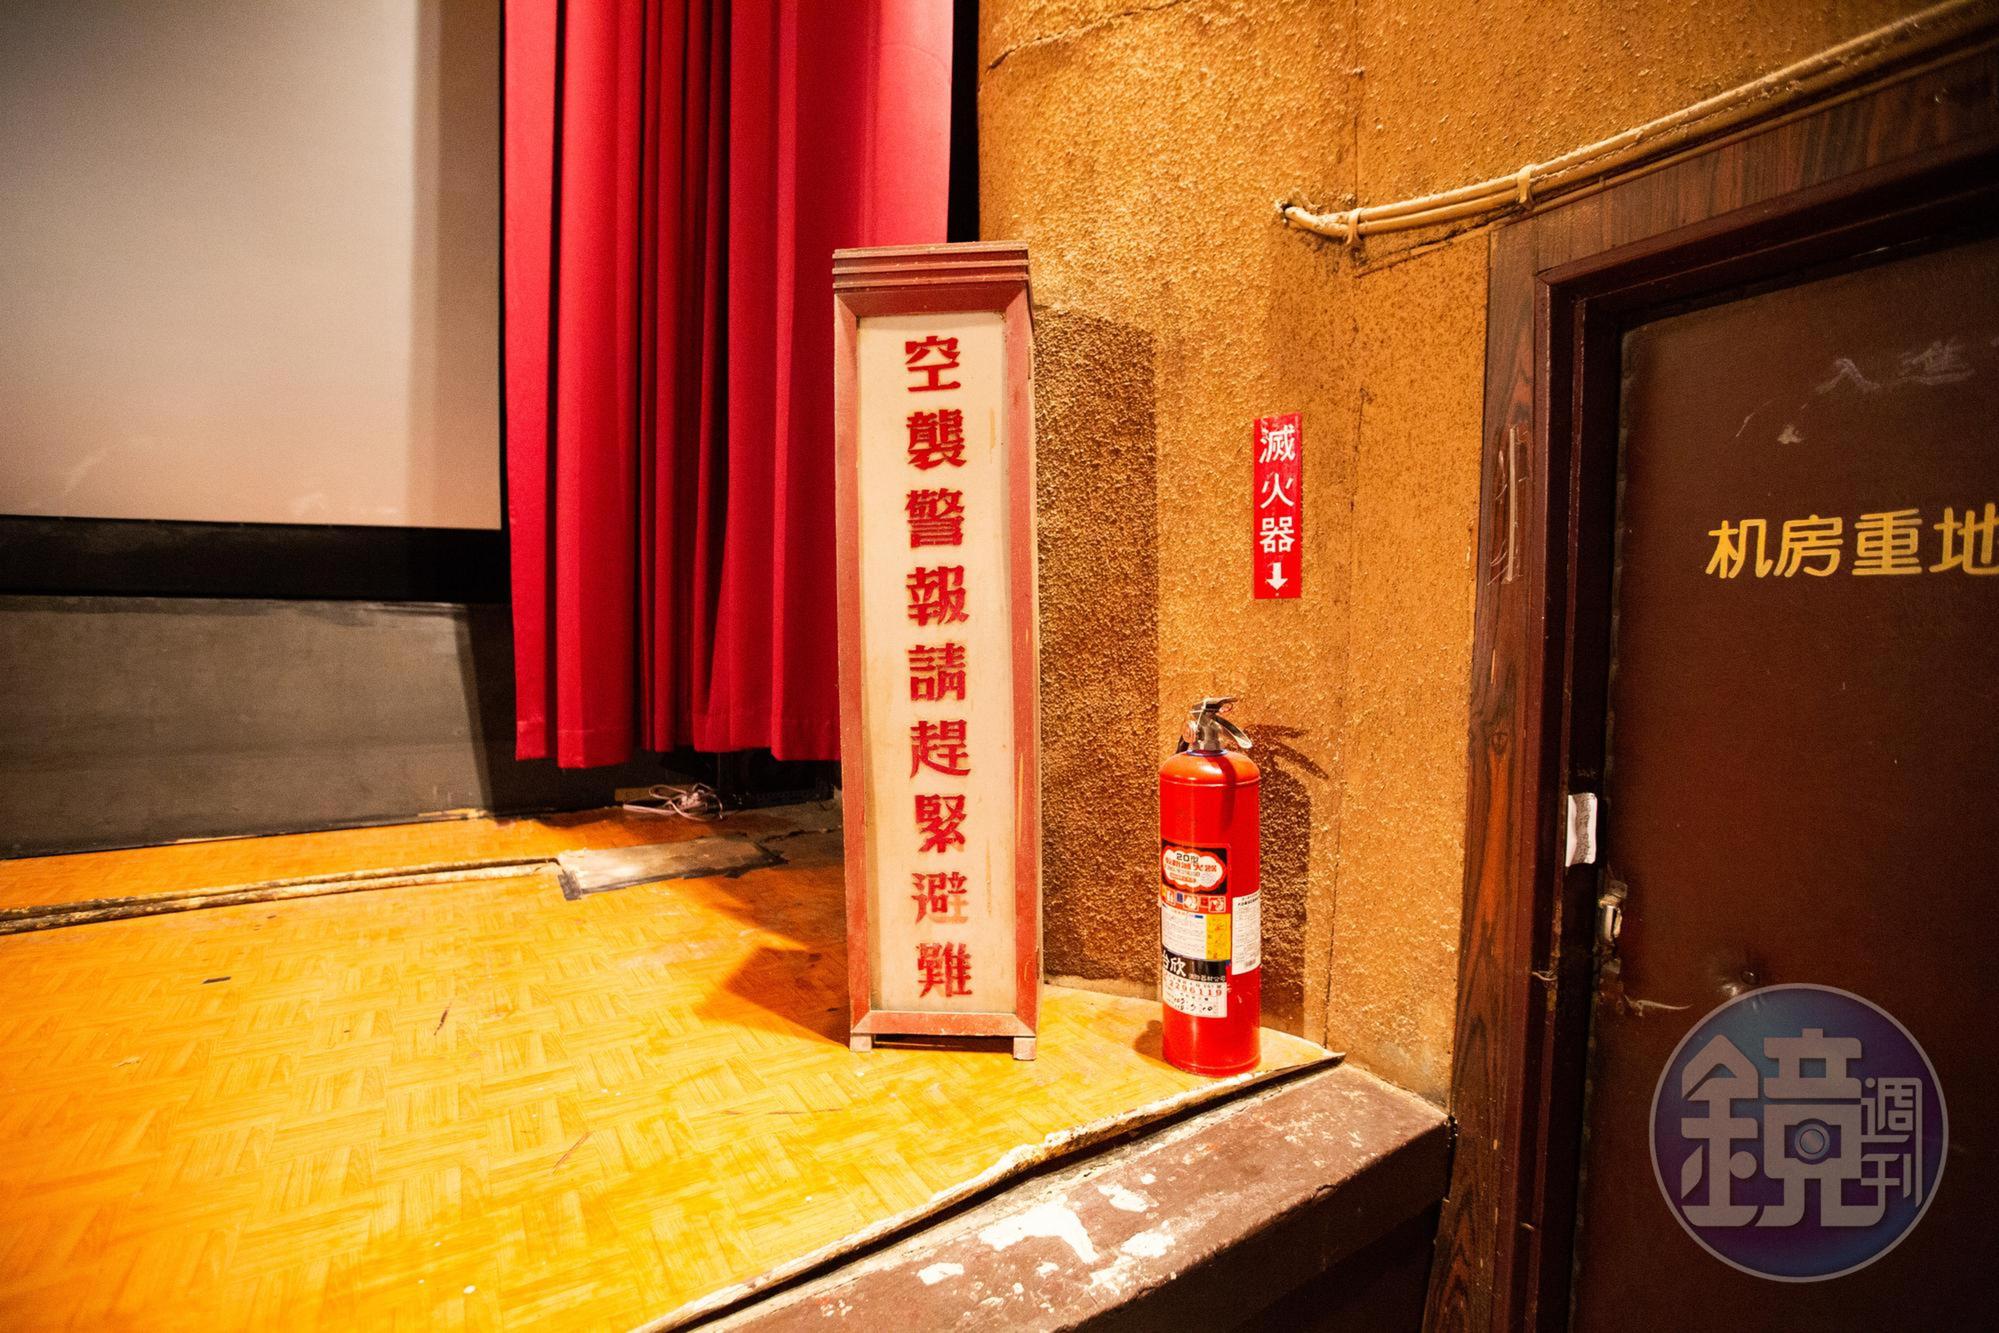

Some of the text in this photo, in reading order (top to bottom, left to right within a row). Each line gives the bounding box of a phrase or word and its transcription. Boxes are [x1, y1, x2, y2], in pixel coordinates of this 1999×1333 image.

[1259, 424, 1297, 553] 滅火器
[1706, 502, 1999, 579] 机房重地
[904, 334, 974, 999] 空襲警報請趕緊避難
